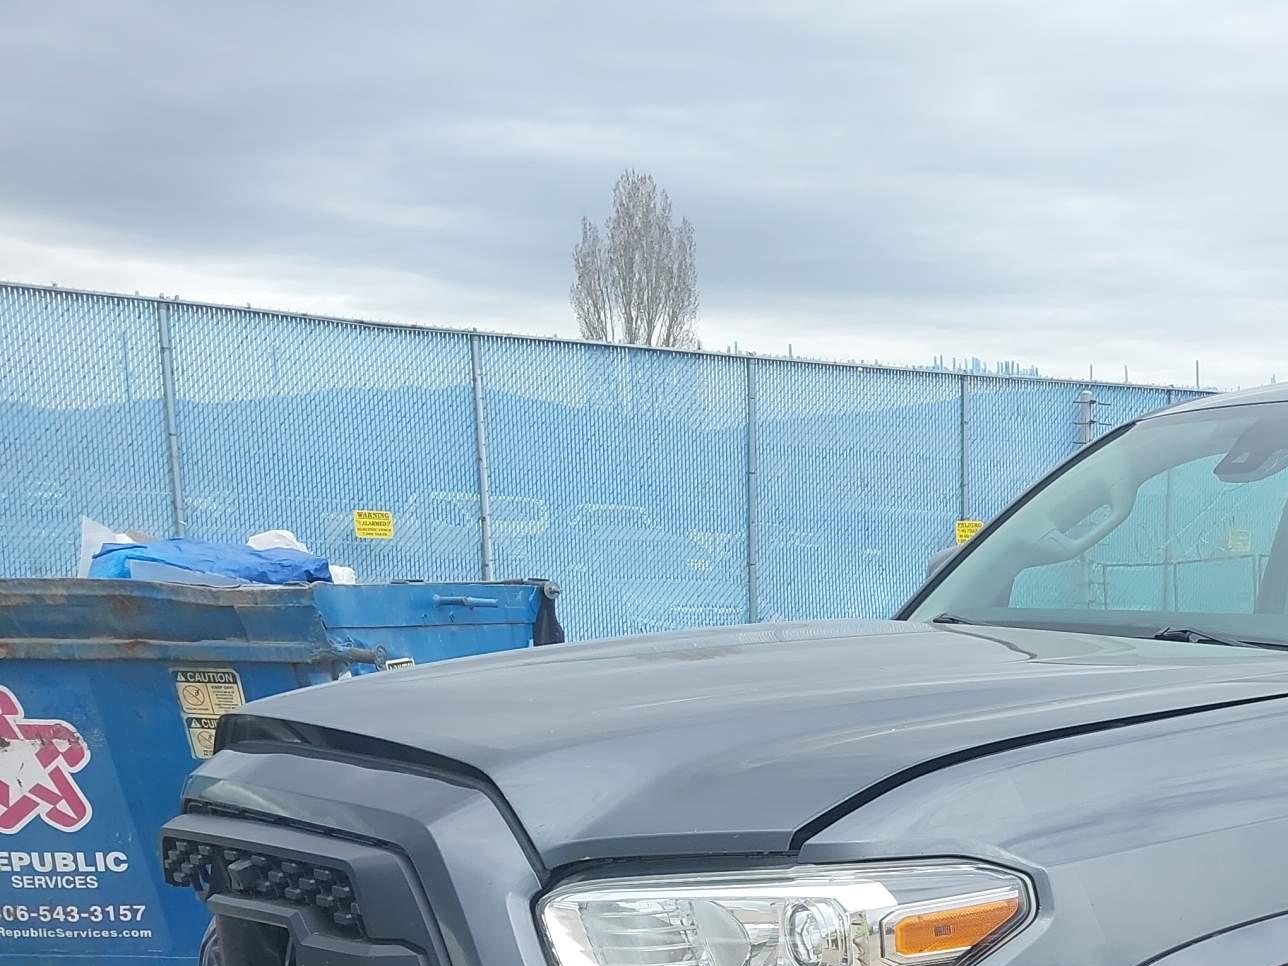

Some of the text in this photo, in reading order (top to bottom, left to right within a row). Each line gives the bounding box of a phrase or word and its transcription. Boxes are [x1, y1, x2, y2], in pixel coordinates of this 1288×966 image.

[186, 672, 233, 683] CAUTION
[11, 875, 98, 889] SERVICES
[0, 904, 146, 922] 06-543-3157
